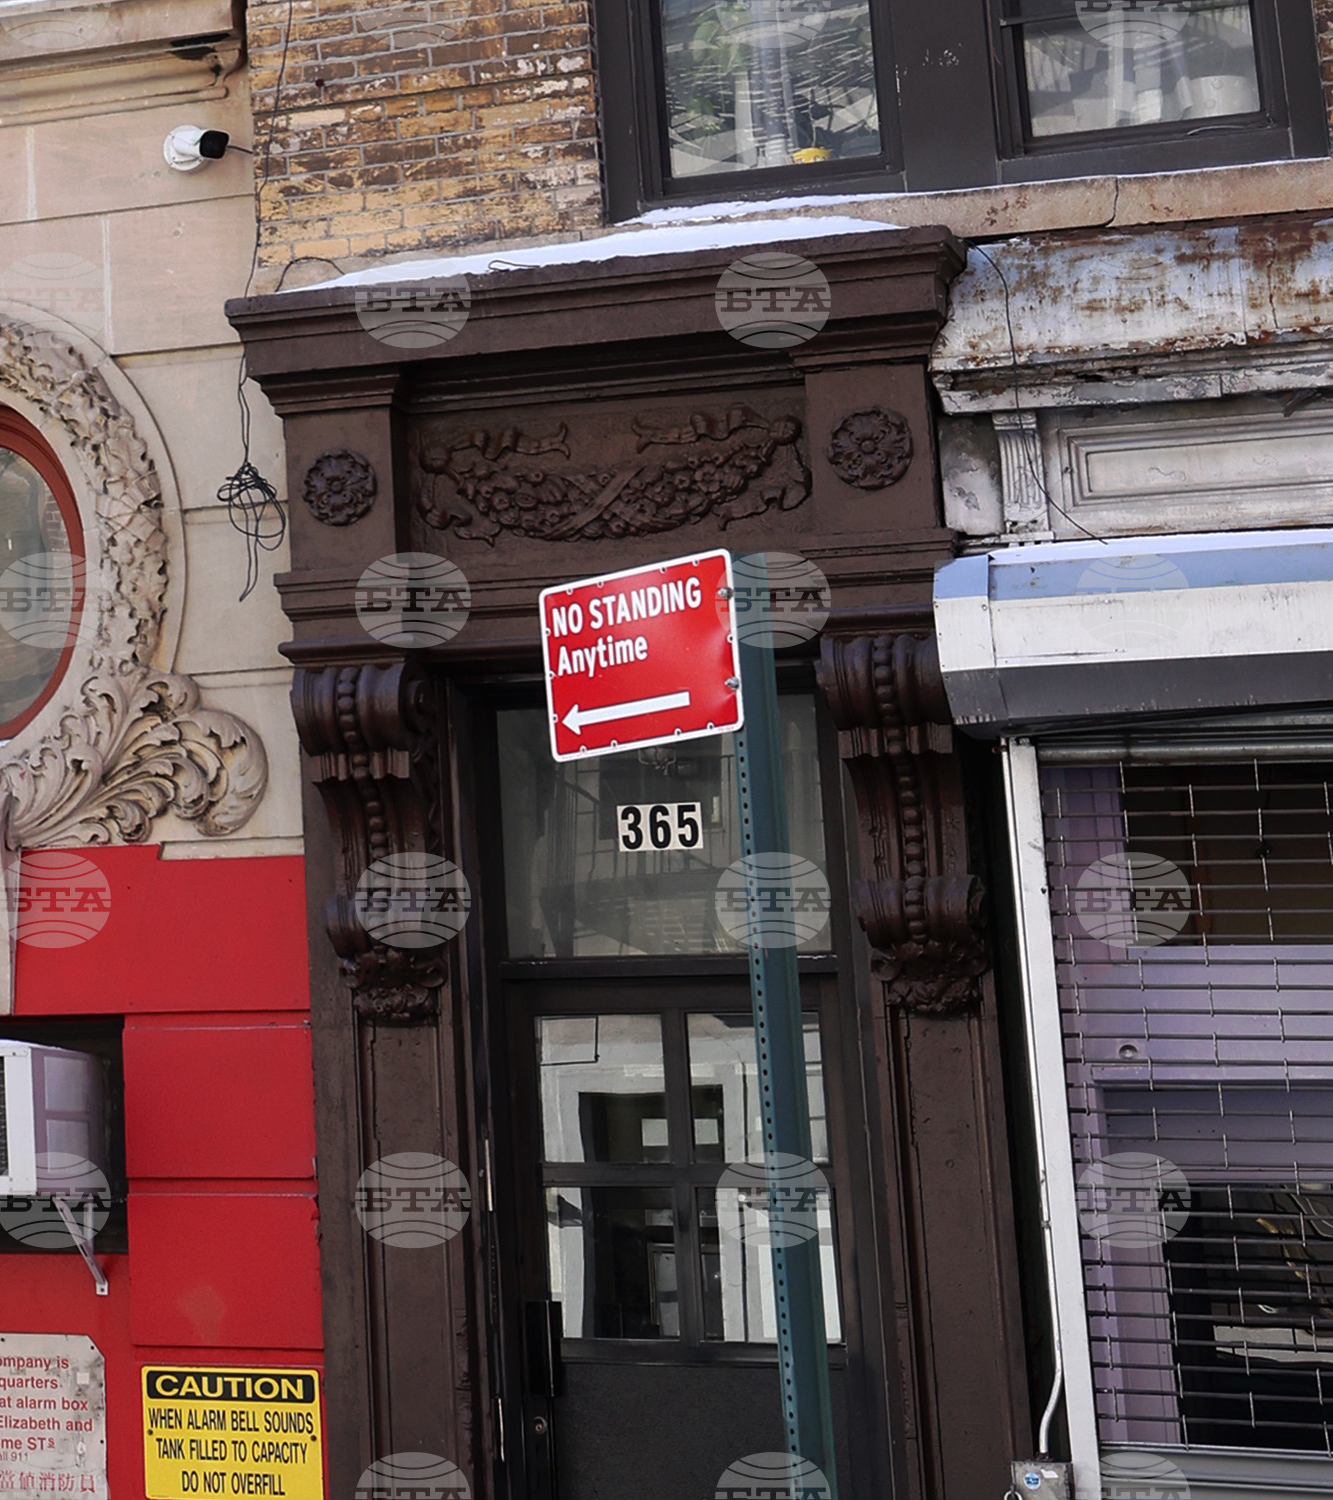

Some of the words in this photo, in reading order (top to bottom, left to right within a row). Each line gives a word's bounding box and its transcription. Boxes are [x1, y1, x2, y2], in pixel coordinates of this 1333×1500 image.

[551, 602, 584, 638] NO
[589, 576, 703, 631] STANDING
[557, 634, 648, 678] Anytime
[620, 802, 700, 850] 365
[56, 1355, 70, 1370] is
[155, 1374, 304, 1400] CAUTION
[16, 1396, 57, 1410] alarm
[61, 1398, 89, 1412] box
[65, 1417, 93, 1432] and
[148, 1407, 183, 1430] WHEN
[186, 1409, 227, 1431] ALARM
[231, 1410, 260, 1433] BELL
[263, 1411, 314, 1434] SOUNDS
[10, 1452, 29, 1462] 911
[155, 1437, 186, 1460] TANK
[189, 1438, 228, 1461] FILLED
[231, 1440, 247, 1463] TO
[251, 1440, 308, 1464] CAPACITY
[181, 1470, 199, 1493] DO
[203, 1471, 227, 1494] NOT
[230, 1472, 286, 1496] OVERFILL
